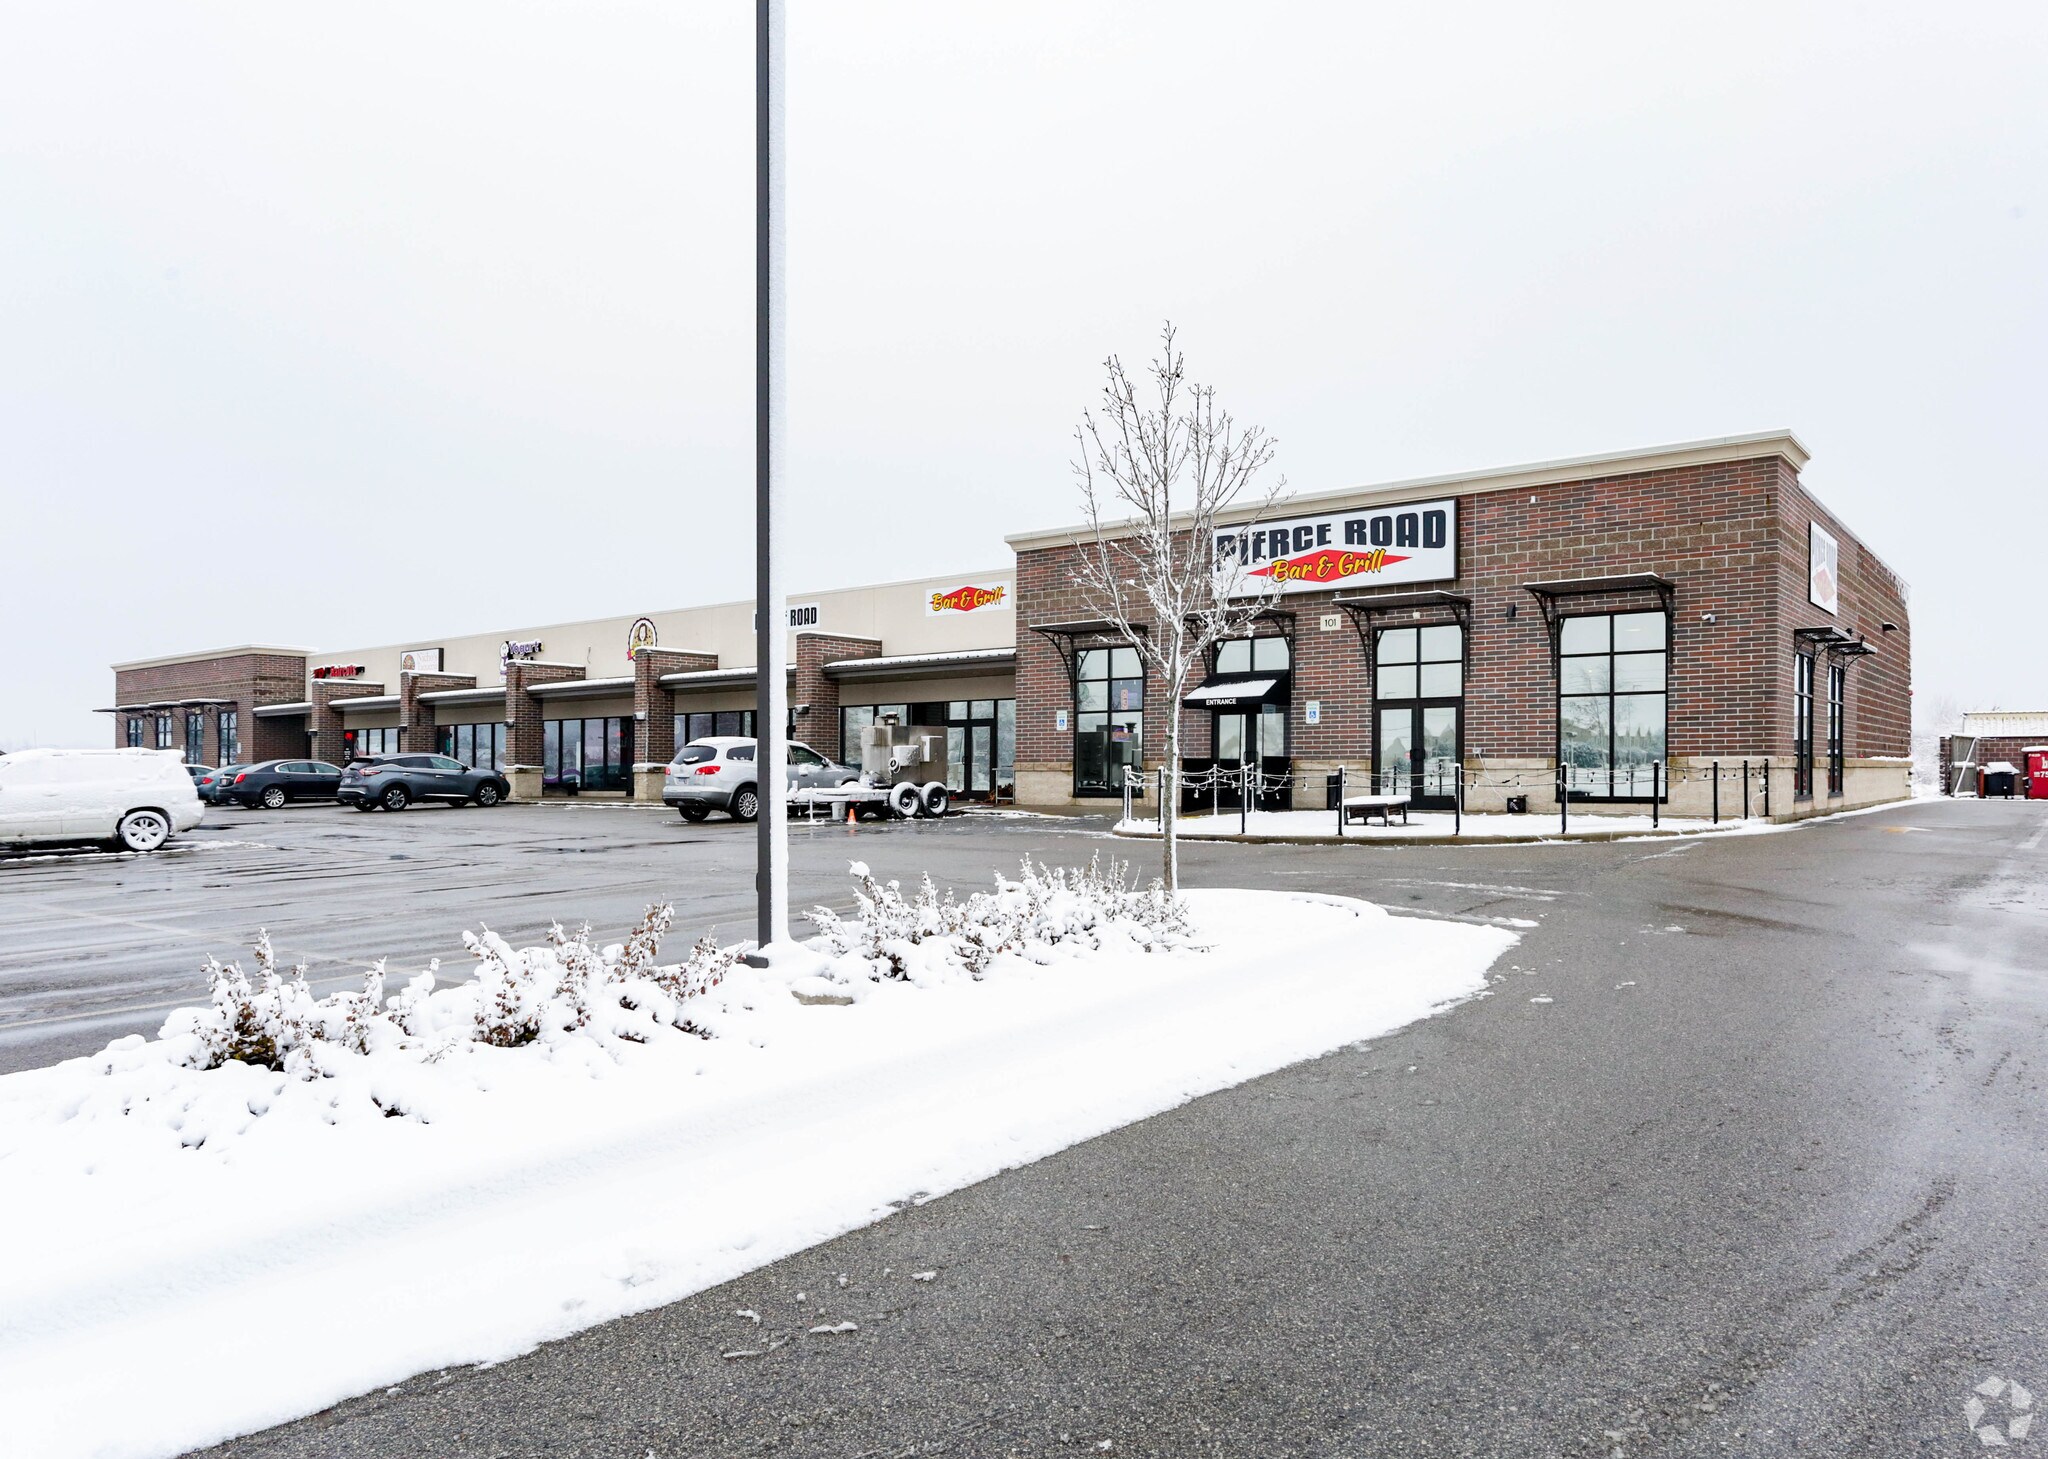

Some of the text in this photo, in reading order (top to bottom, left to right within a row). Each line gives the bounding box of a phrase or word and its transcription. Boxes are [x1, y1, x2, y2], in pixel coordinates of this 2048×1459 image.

[1216, 509, 1446, 572] PIERCE ROAD
[1271, 548, 1387, 583] Bar & Grill
[932, 585, 1004, 612] Bar & Grill
[790, 607, 817, 627] ROAD
[1324, 618, 1337, 628] 101
[1206, 697, 1236, 706] ENTRANCE
